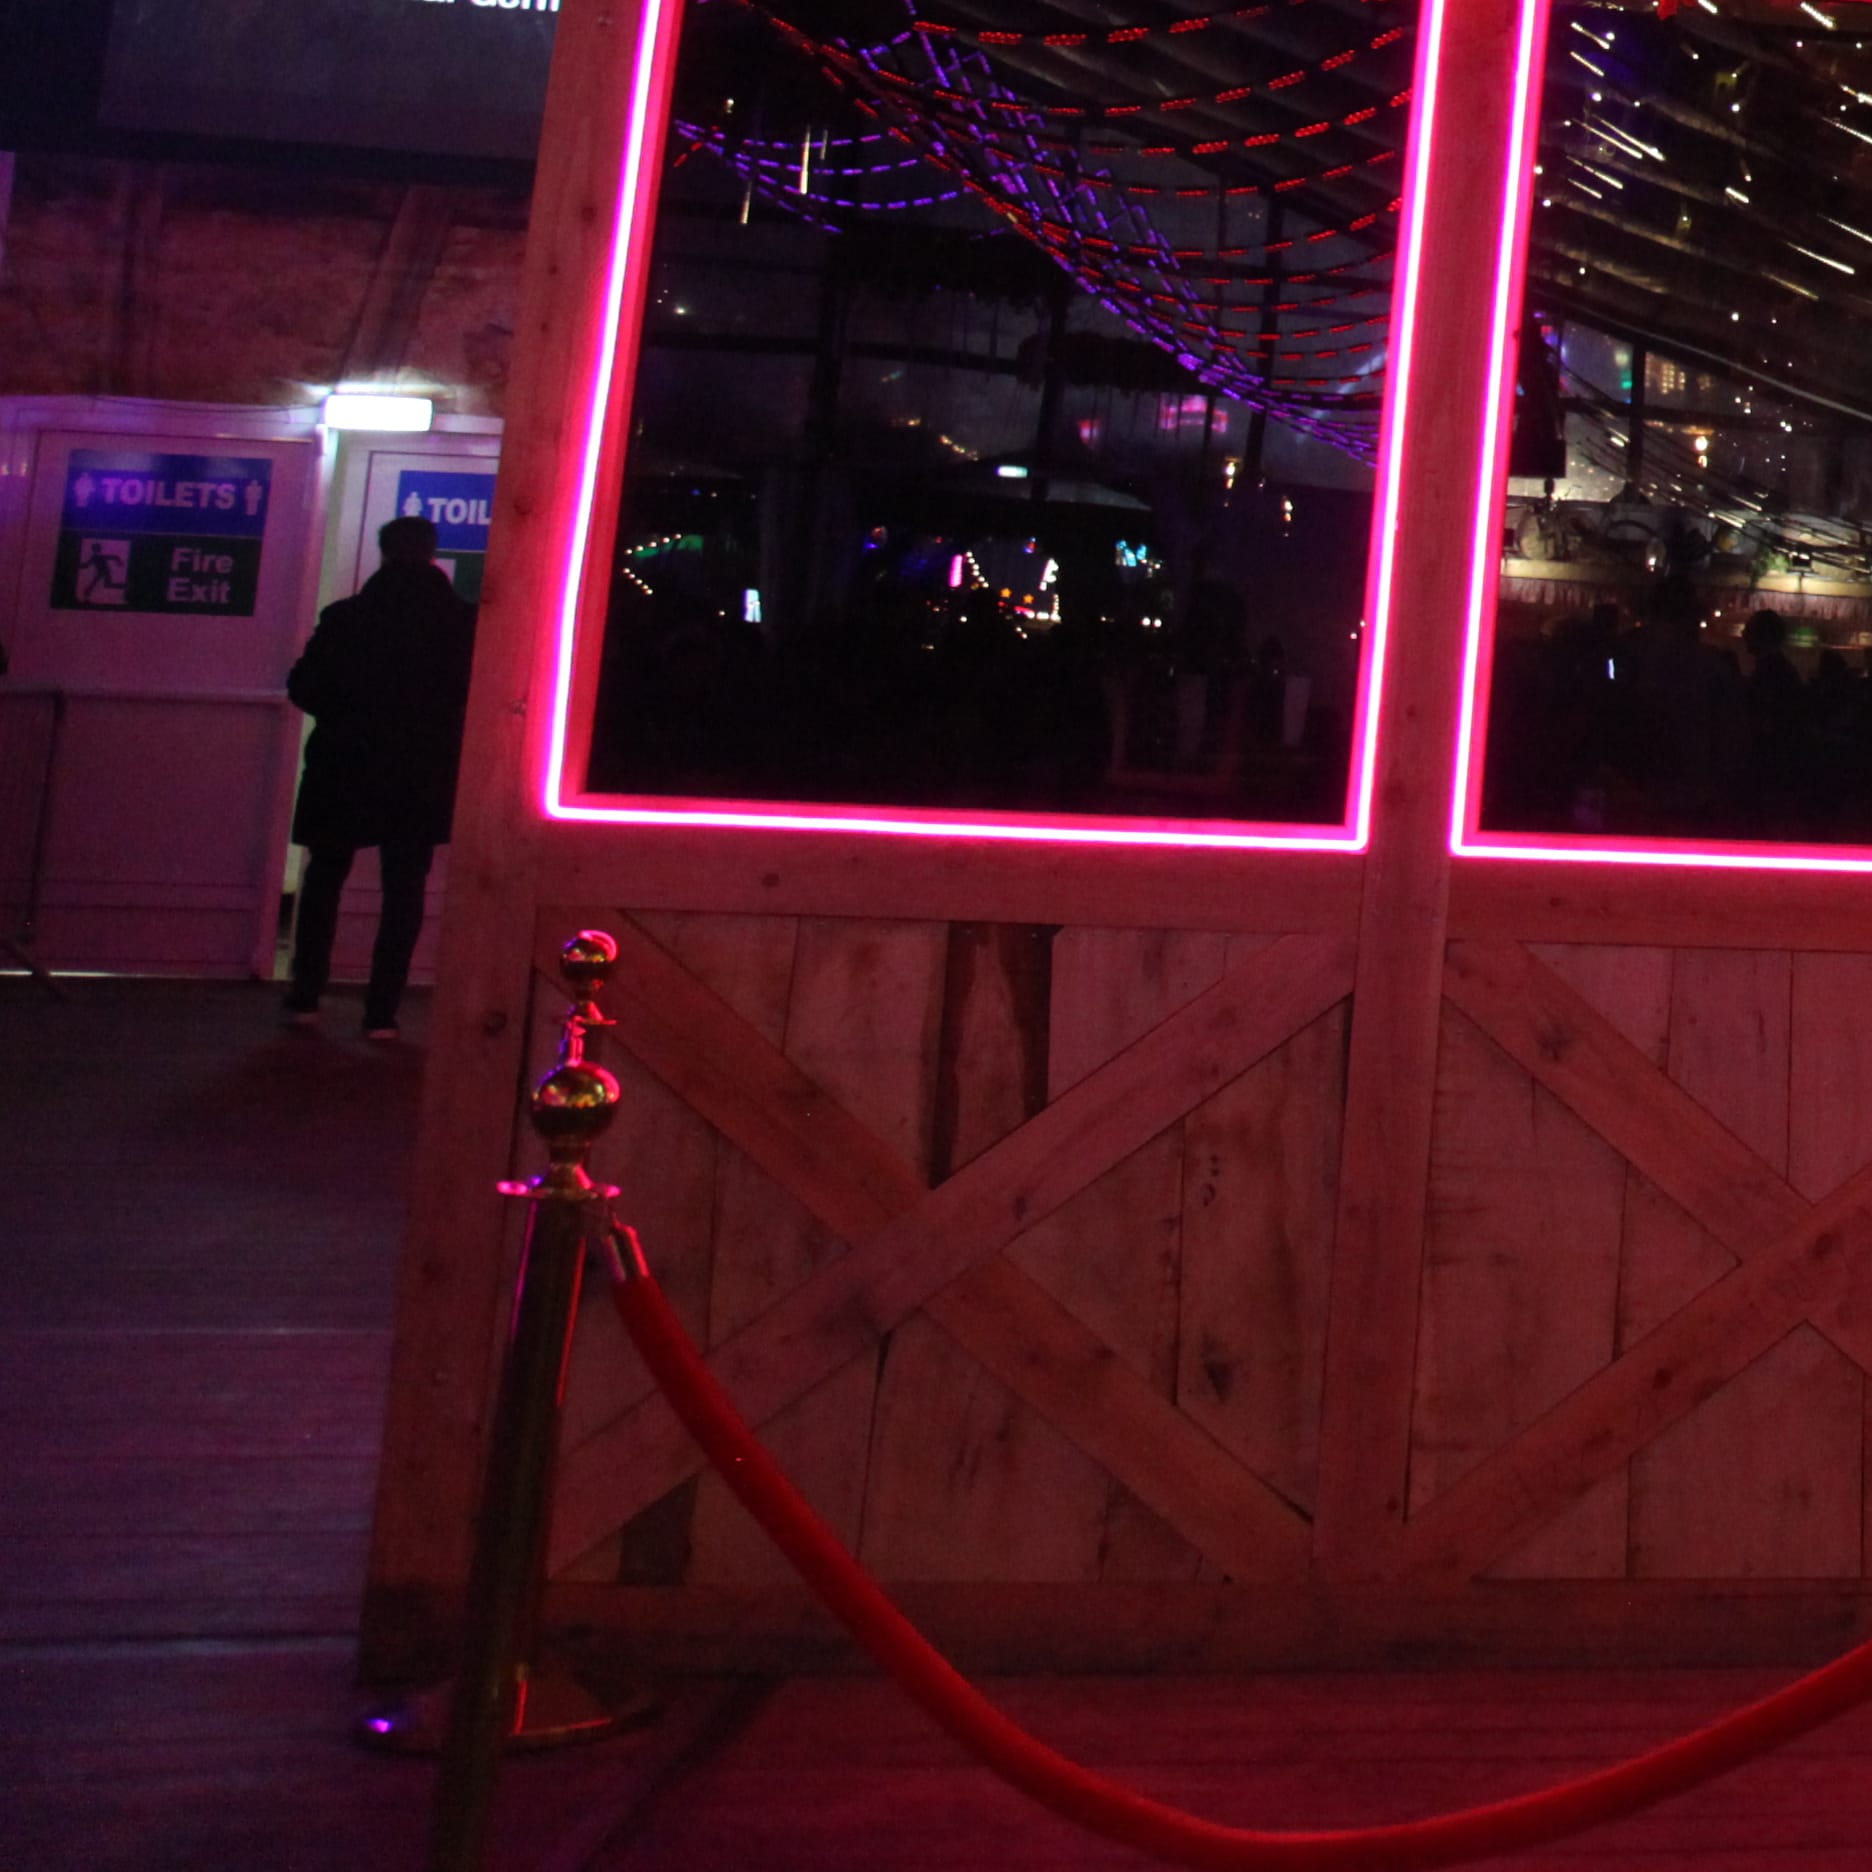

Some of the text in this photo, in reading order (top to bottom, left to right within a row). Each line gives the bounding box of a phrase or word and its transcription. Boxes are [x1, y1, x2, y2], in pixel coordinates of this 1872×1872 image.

[101, 477, 237, 511] TOILETS
[427, 497, 493, 526] TOIL
[170, 547, 235, 574] Fire
[166, 577, 232, 604] Exit
